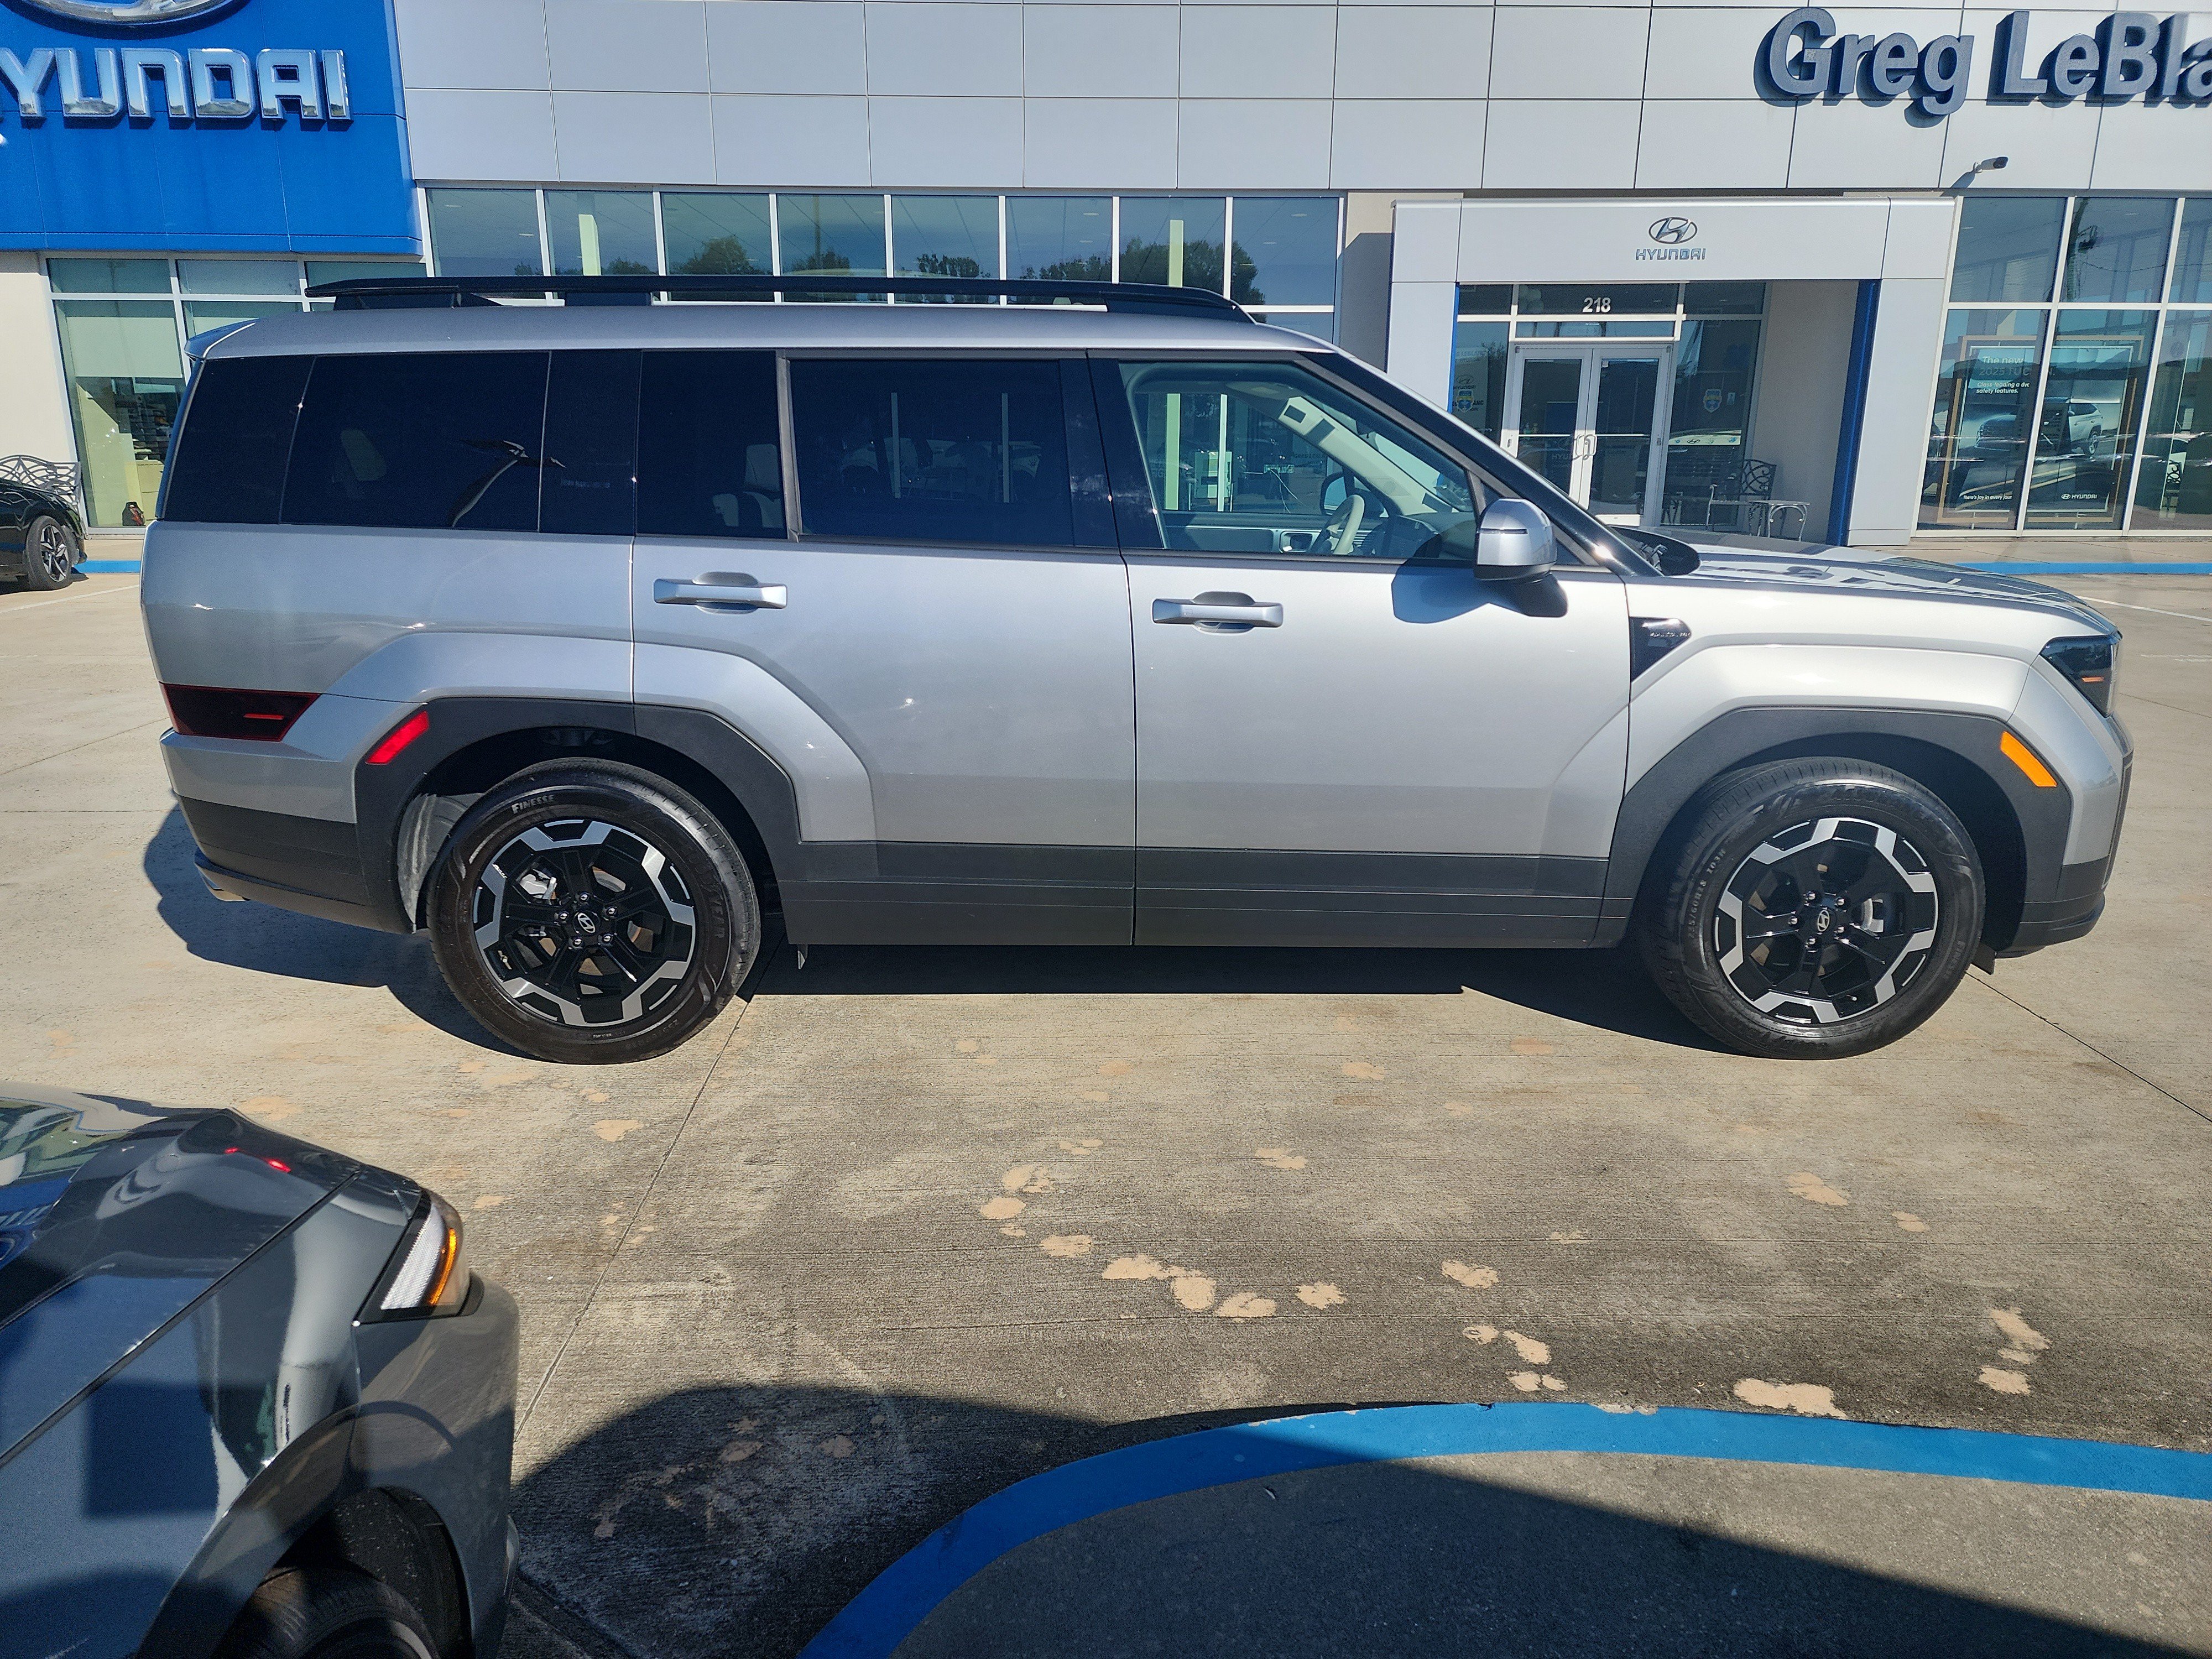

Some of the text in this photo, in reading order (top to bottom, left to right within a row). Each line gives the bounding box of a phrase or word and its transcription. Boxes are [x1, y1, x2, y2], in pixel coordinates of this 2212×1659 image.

[1765, 7, 1975, 117] Greg
[1635, 248, 1707, 260] HYUNDAI
[1582, 297, 1611, 313] 218
[1979, 367, 2006, 376] 2025
[511, 794, 554, 814] FINESSE
